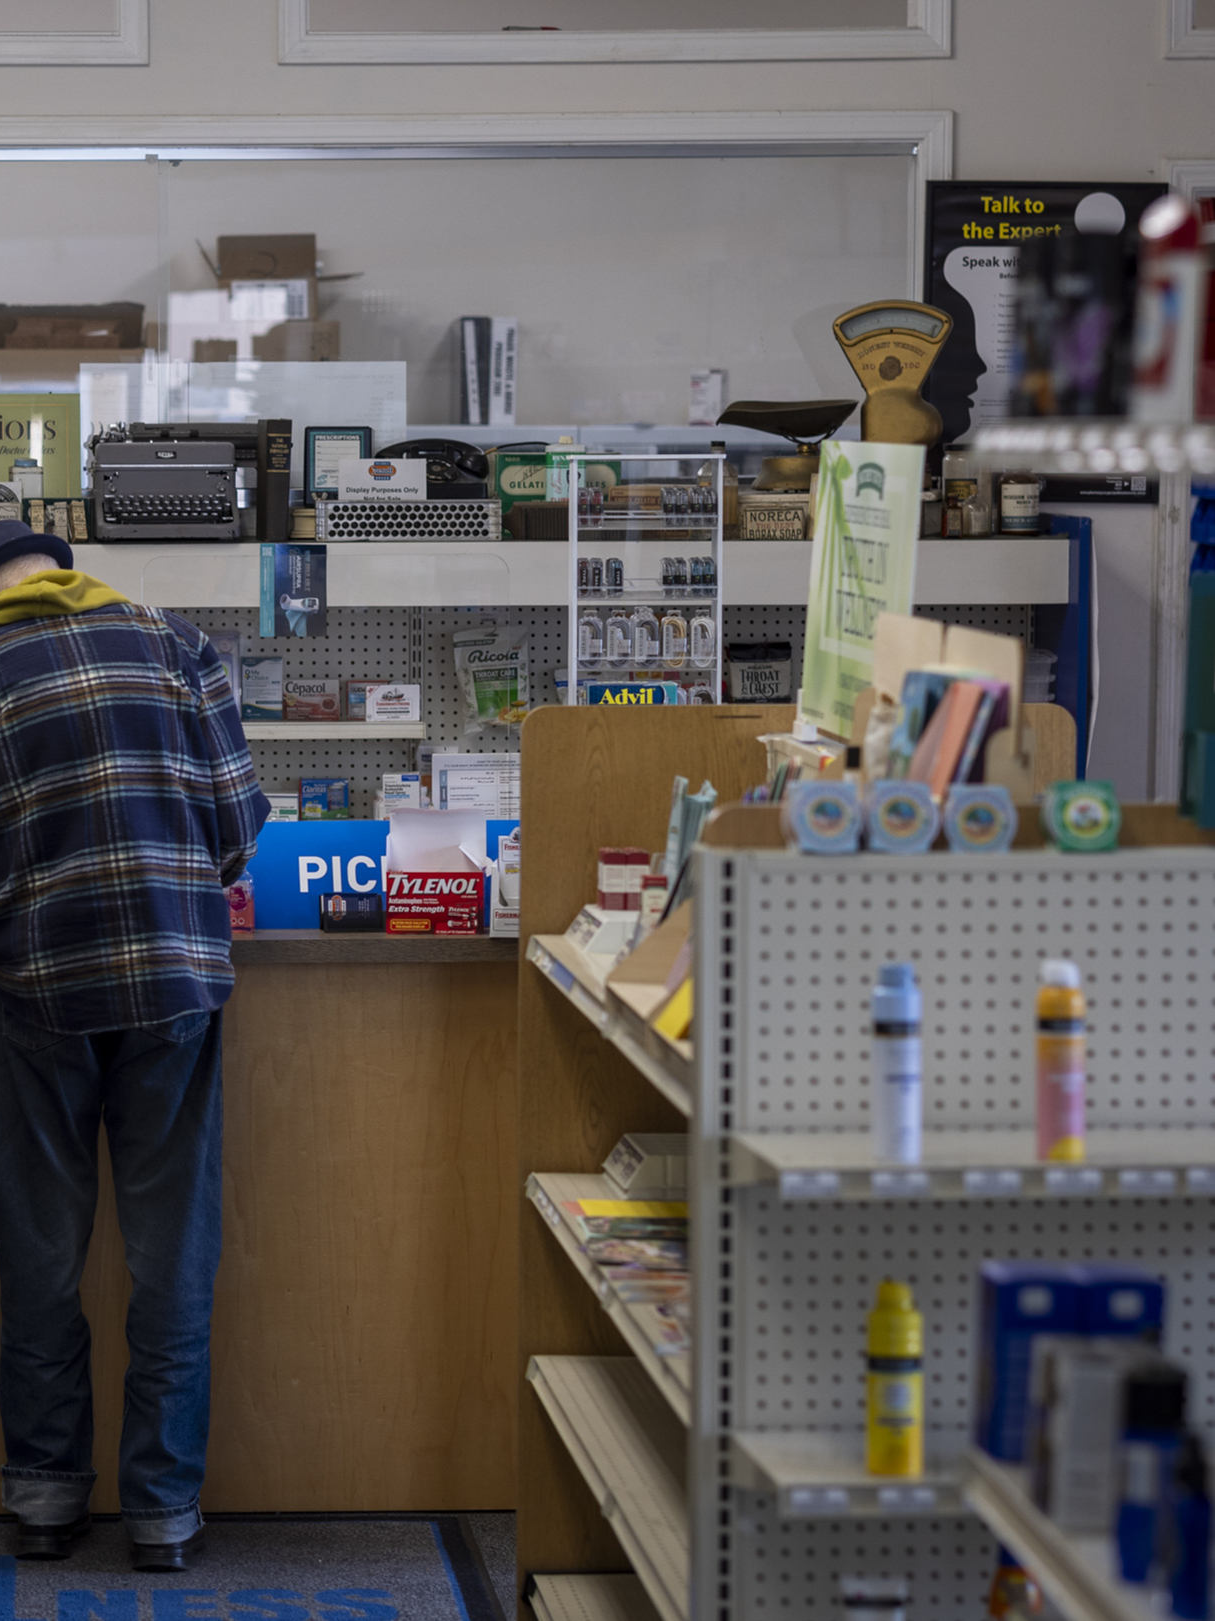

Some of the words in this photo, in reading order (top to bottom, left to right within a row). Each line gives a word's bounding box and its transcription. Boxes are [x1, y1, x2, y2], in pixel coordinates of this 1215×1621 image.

[980, 196, 1021, 214] Talk
[1024, 198, 1045, 214] to
[962, 221, 994, 239] the
[999, 222, 1061, 242] Expert
[962, 256, 999, 269] Speak
[0, 446, 26, 456] Doctor
[346, 486, 370, 495] Display
[403, 487, 419, 495] Only
[509, 481, 544, 489] GELATI
[750, 511, 801, 522] NORECA
[749, 529, 777, 540] BORAX
[779, 529, 802, 540] SOAP
[467, 649, 520, 664] Ricola
[475, 671, 499, 679] THROAT
[739, 669, 781, 683] THROAT
[598, 687, 654, 705] Advil
[740, 683, 749, 695] &
[749, 681, 782, 699] CHEST
[302, 785, 327, 794] Claritin
[388, 874, 479, 897] TYLENOL
[388, 905, 410, 913] Extra
[410, 905, 445, 914] Strength
